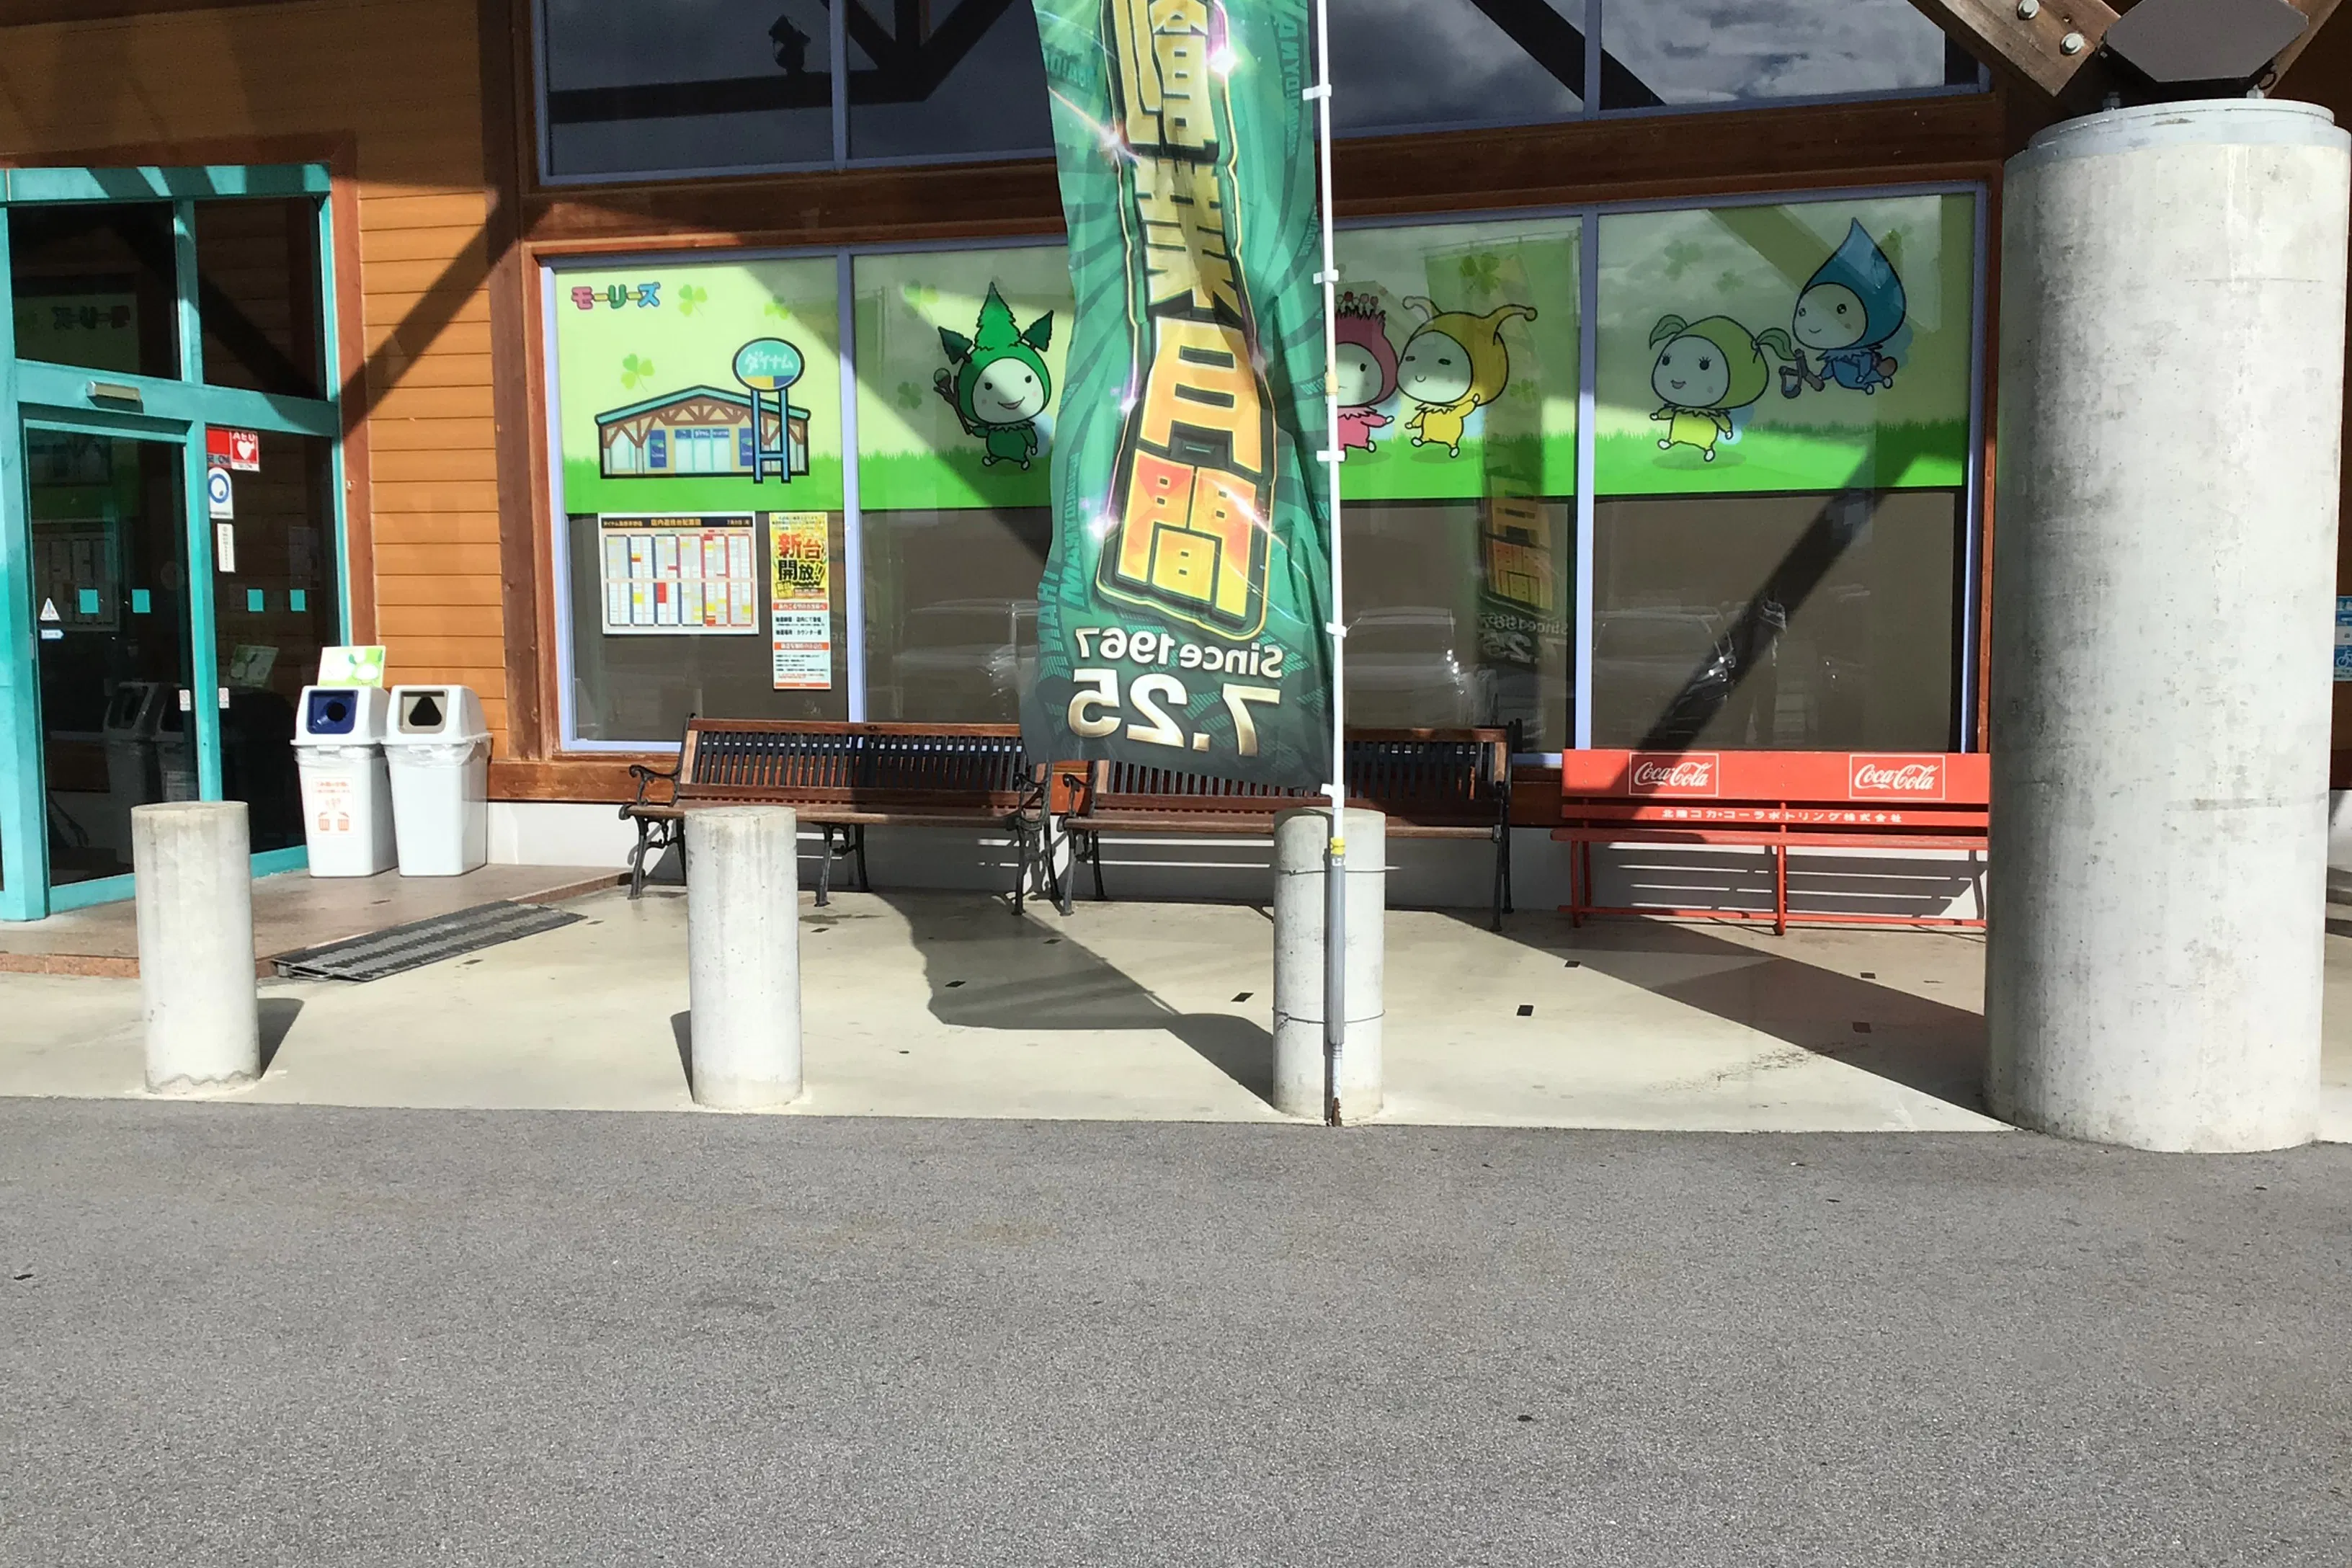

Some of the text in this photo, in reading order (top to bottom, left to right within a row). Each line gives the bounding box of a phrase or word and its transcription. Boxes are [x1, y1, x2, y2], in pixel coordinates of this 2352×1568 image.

[571, 282, 661, 310] モーリーズ
[744, 351, 793, 373] ダイナム
[778, 533, 821, 558] 新台
[1634, 762, 1713, 787] Coca-Cola
[1854, 764, 1940, 790] Coca-Cola
